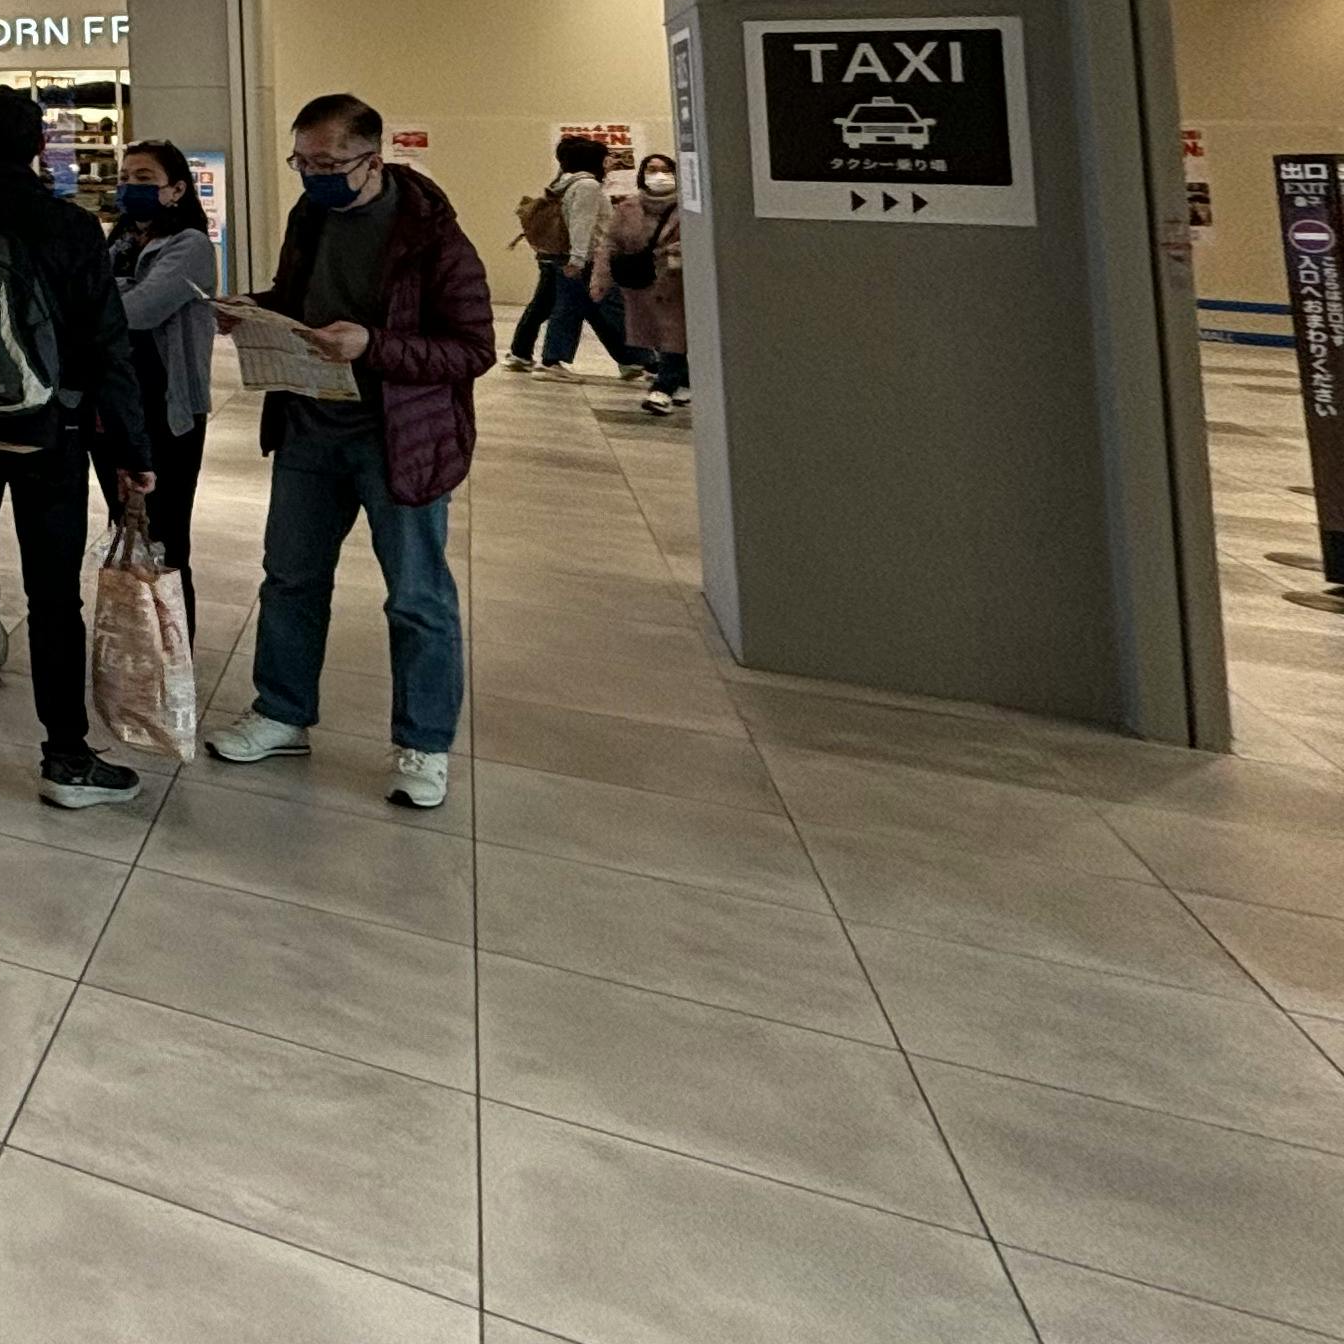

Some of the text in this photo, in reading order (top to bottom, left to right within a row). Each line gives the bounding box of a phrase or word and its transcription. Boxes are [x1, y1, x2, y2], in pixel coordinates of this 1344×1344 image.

[793, 42, 964, 83] TAXI
[829, 158, 948, 172] タクシー乗り場
[1280, 163, 1328, 180] 出口
[1284, 182, 1327, 195] EXIT
